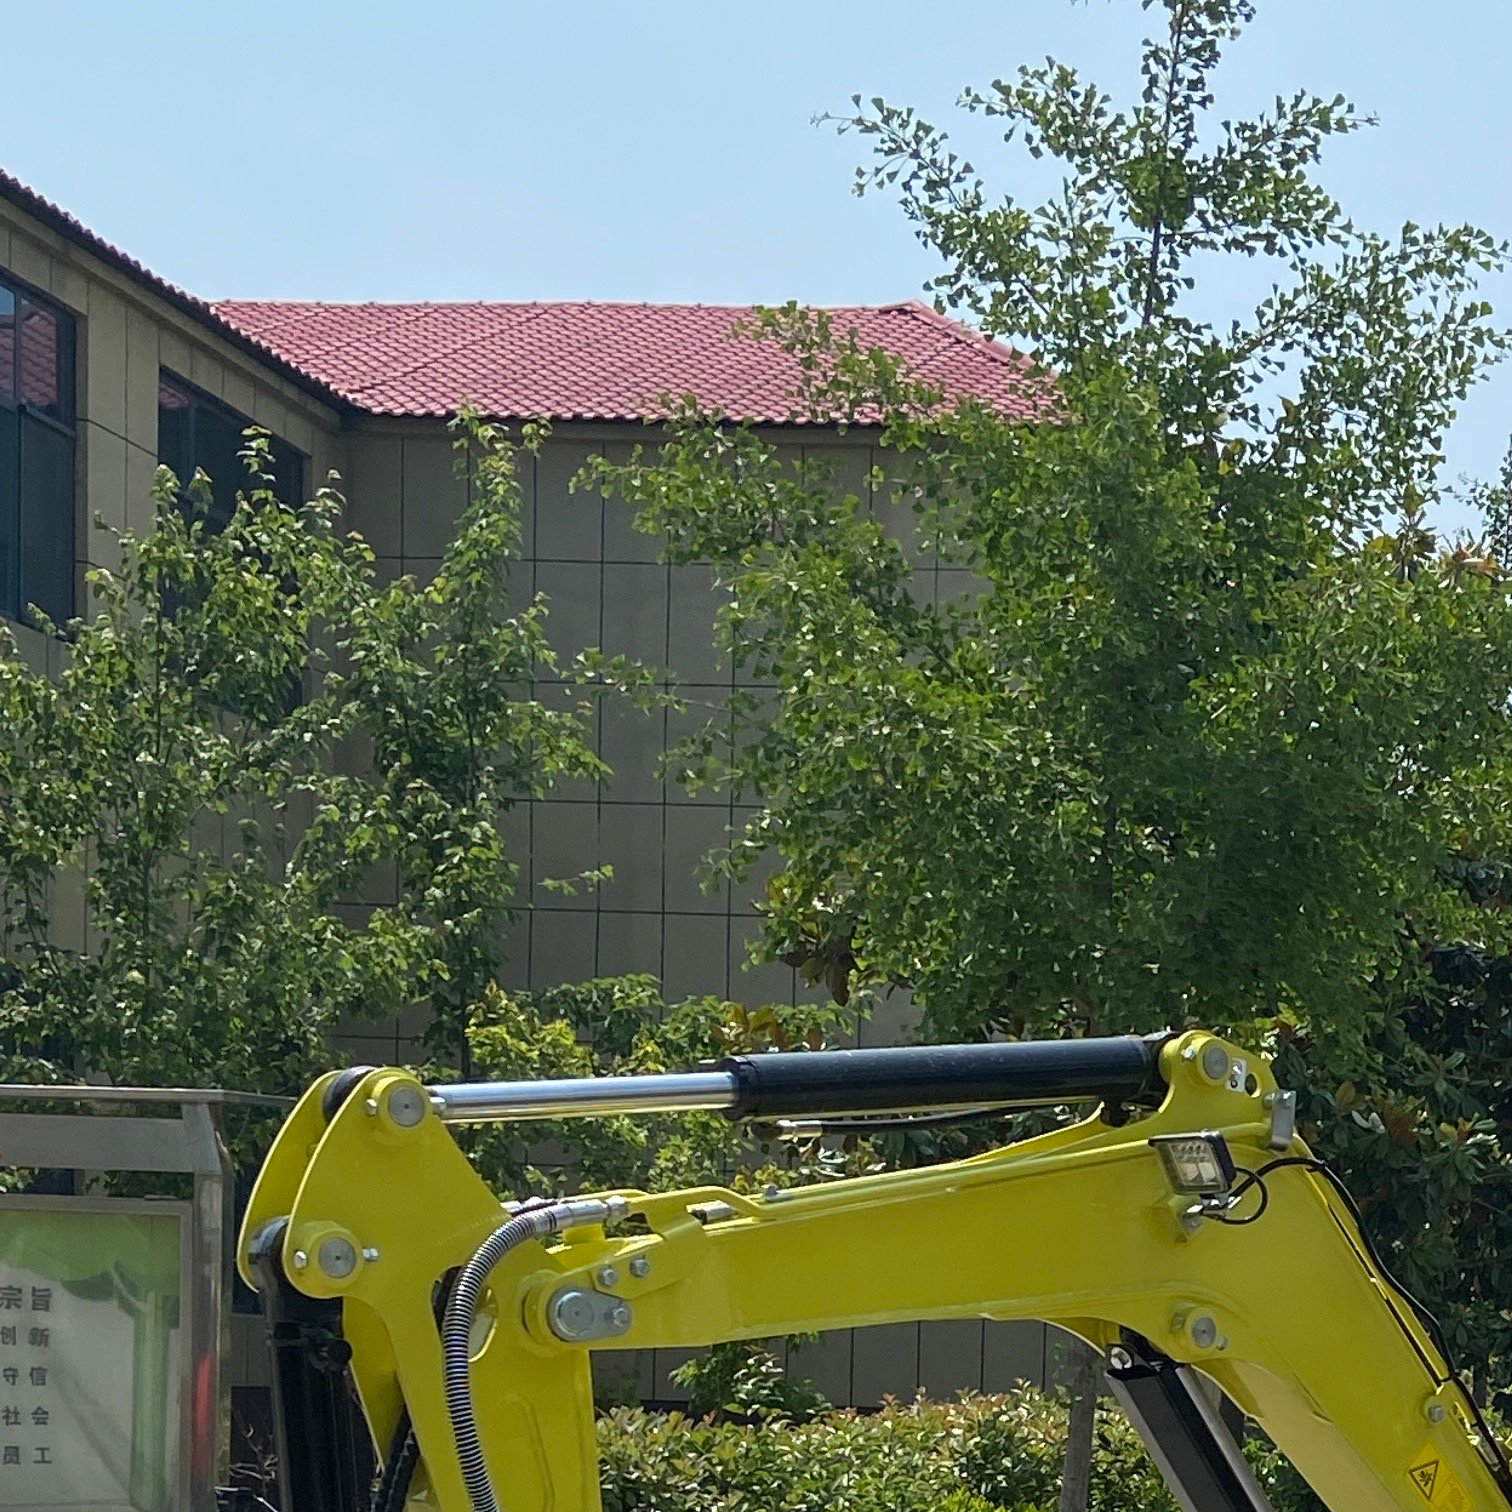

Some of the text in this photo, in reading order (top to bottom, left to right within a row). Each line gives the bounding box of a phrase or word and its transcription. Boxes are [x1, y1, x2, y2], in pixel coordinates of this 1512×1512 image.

[0, 1285, 51, 1312] 宗旨
[0, 1325, 49, 1348] 创新
[3, 1367, 47, 1387] 守信
[2, 1405, 49, 1426] 社会
[3, 1446, 52, 1465] 员工
